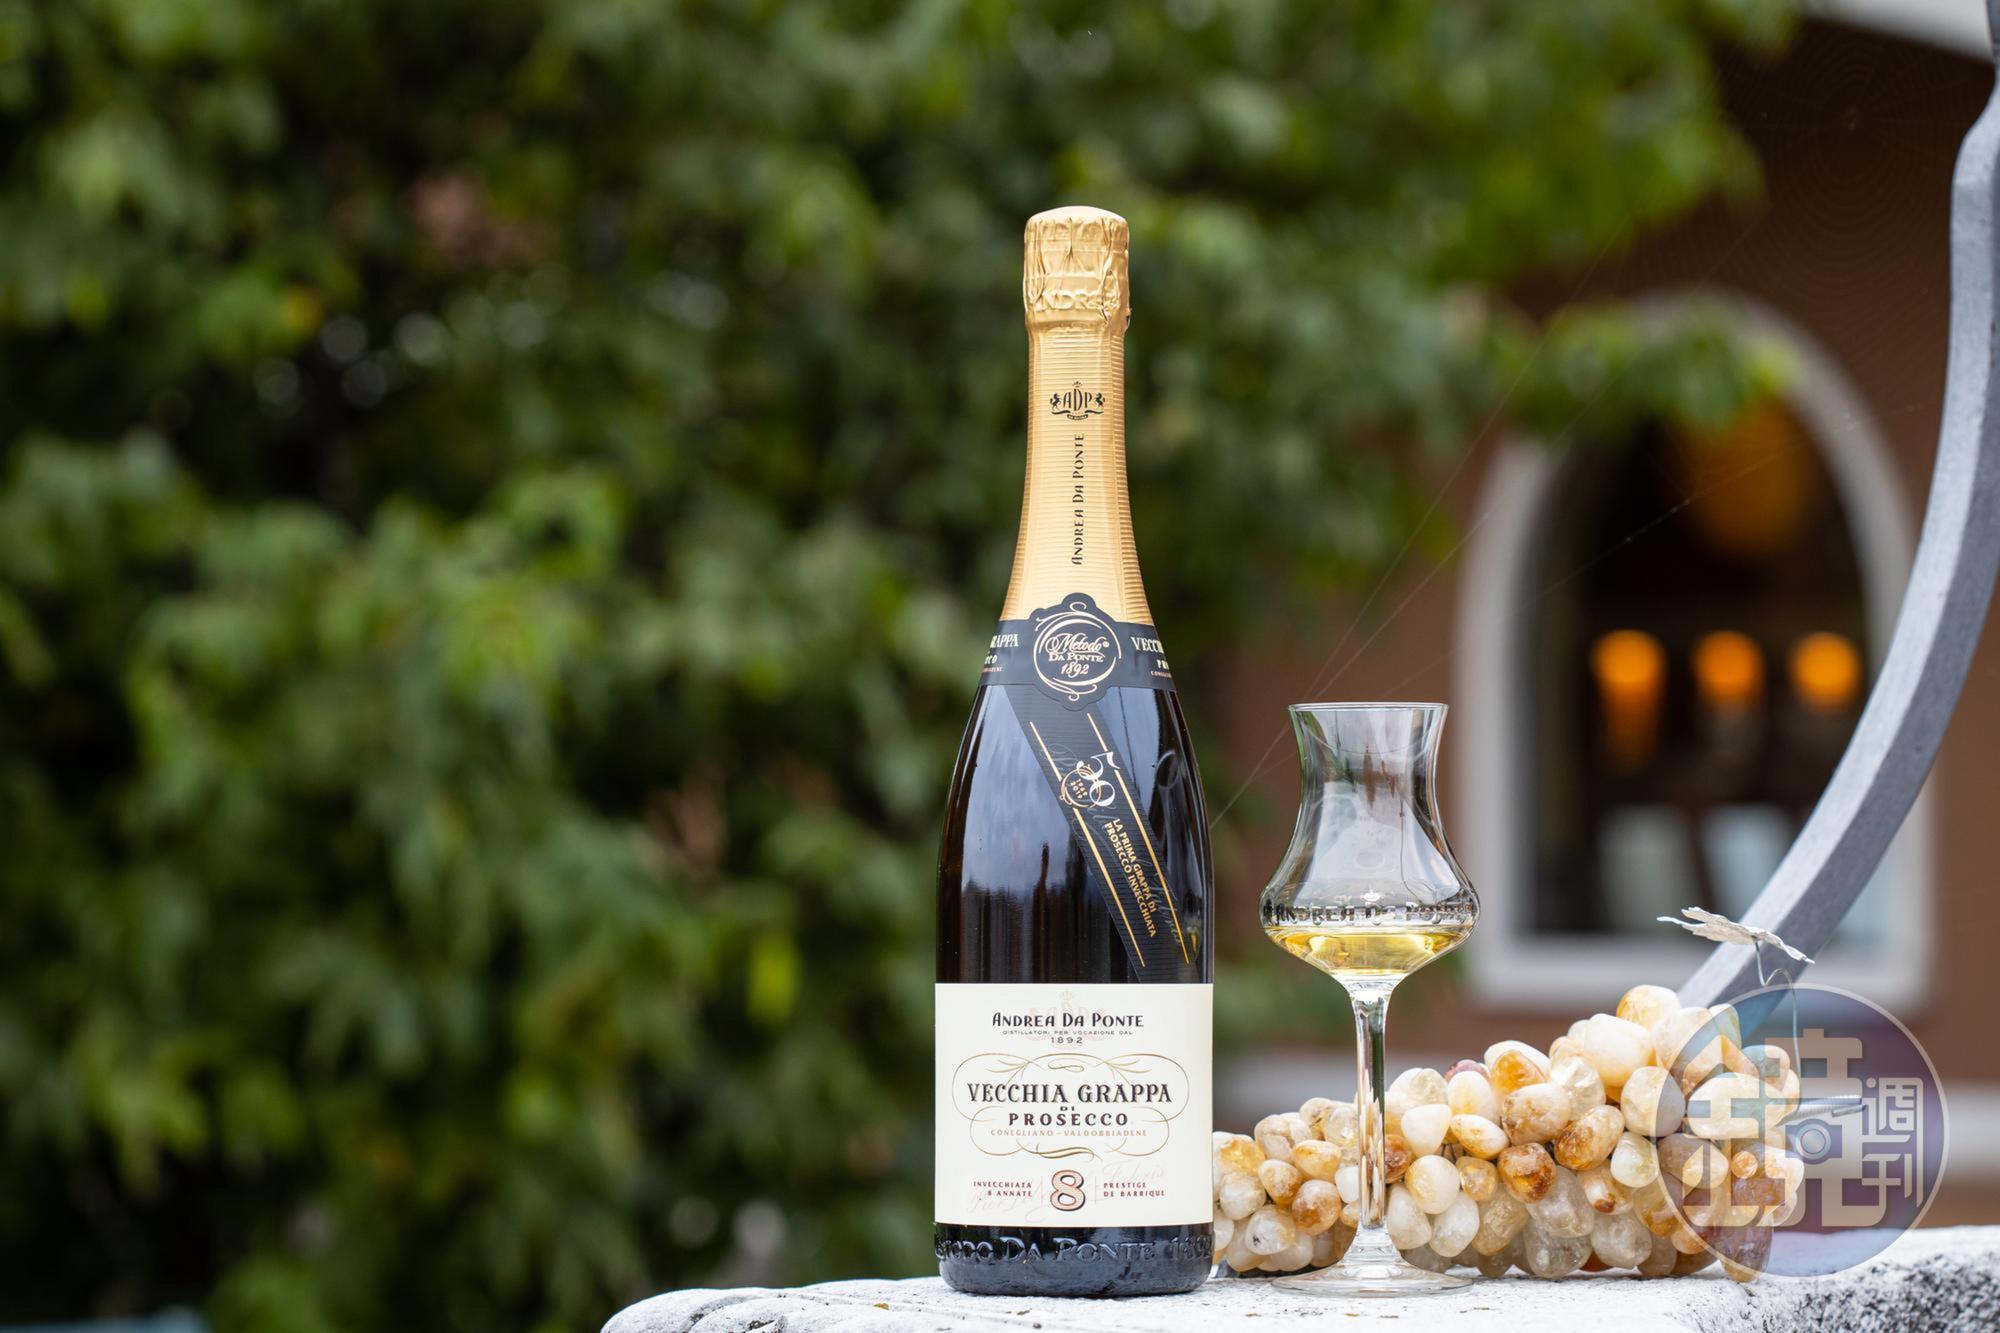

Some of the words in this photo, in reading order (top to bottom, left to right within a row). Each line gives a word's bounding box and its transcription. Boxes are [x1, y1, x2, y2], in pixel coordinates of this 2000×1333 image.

[1062, 388, 1093, 411] ADP
[1072, 433, 1085, 479] PONTE
[1071, 509, 1085, 565] ANDREA
[1067, 652, 1104, 663] PONTE
[1060, 660, 1090, 679] 1892
[1112, 818, 1124, 832] LA
[1119, 831, 1137, 863] PRIMA
[1133, 863, 1152, 900] GRAPPA
[1147, 900, 1157, 913] DI
[1104, 822, 1132, 873] PROSECCO
[1127, 874, 1157, 938] INVECCHIATA
[992, 1012, 1055, 1027] ANDREA
[1092, 1012, 1144, 1027] PONTE
[1051, 1036, 1083, 1044] 1892
[967, 1083, 1069, 1103] VECCHIA
[1077, 1083, 1172, 1103] GRAPPA
[1008, 1112, 1129, 1127] PROSECCO
[990, 1129, 1054, 1137] CONEGLIANO
[1063, 1129, 1147, 1137] VALDOBBIADENE
[973, 1181, 1032, 1189] INVECCHIATA
[996, 1189, 1032, 1198] ANNATE
[1049, 1169, 1087, 1213] 8
[1103, 1190, 1115, 1198] DE
[1120, 1189, 1166, 1198] BARRIQUE
[1052, 1236, 1155, 1263] PONTE
